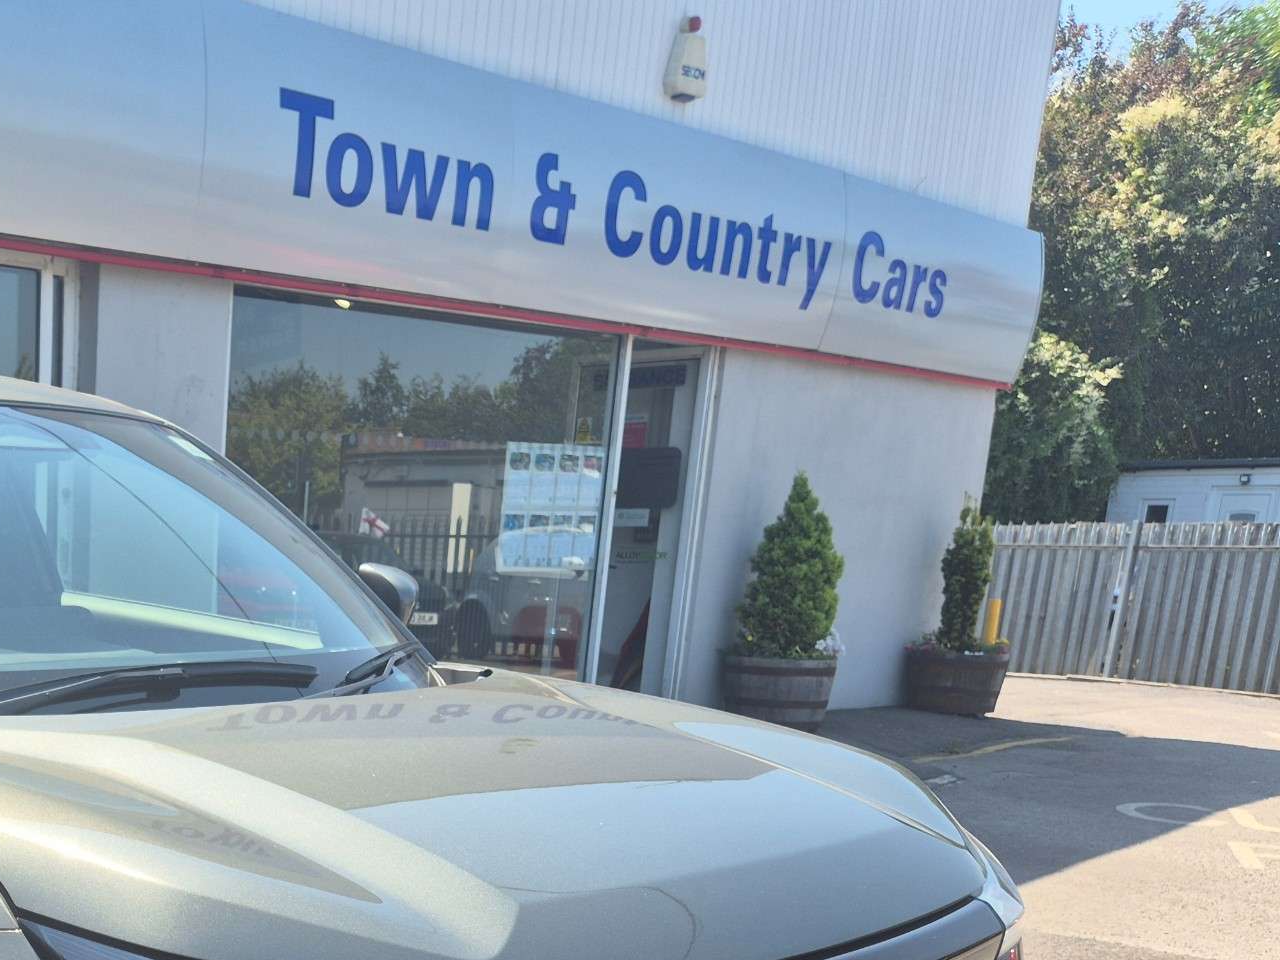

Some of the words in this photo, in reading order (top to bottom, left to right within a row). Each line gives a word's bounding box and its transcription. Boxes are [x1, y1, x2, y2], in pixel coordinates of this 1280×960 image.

[279, 86, 494, 232] Town
[529, 151, 577, 246] &
[604, 169, 832, 311] Country
[851, 230, 947, 319] Cars
